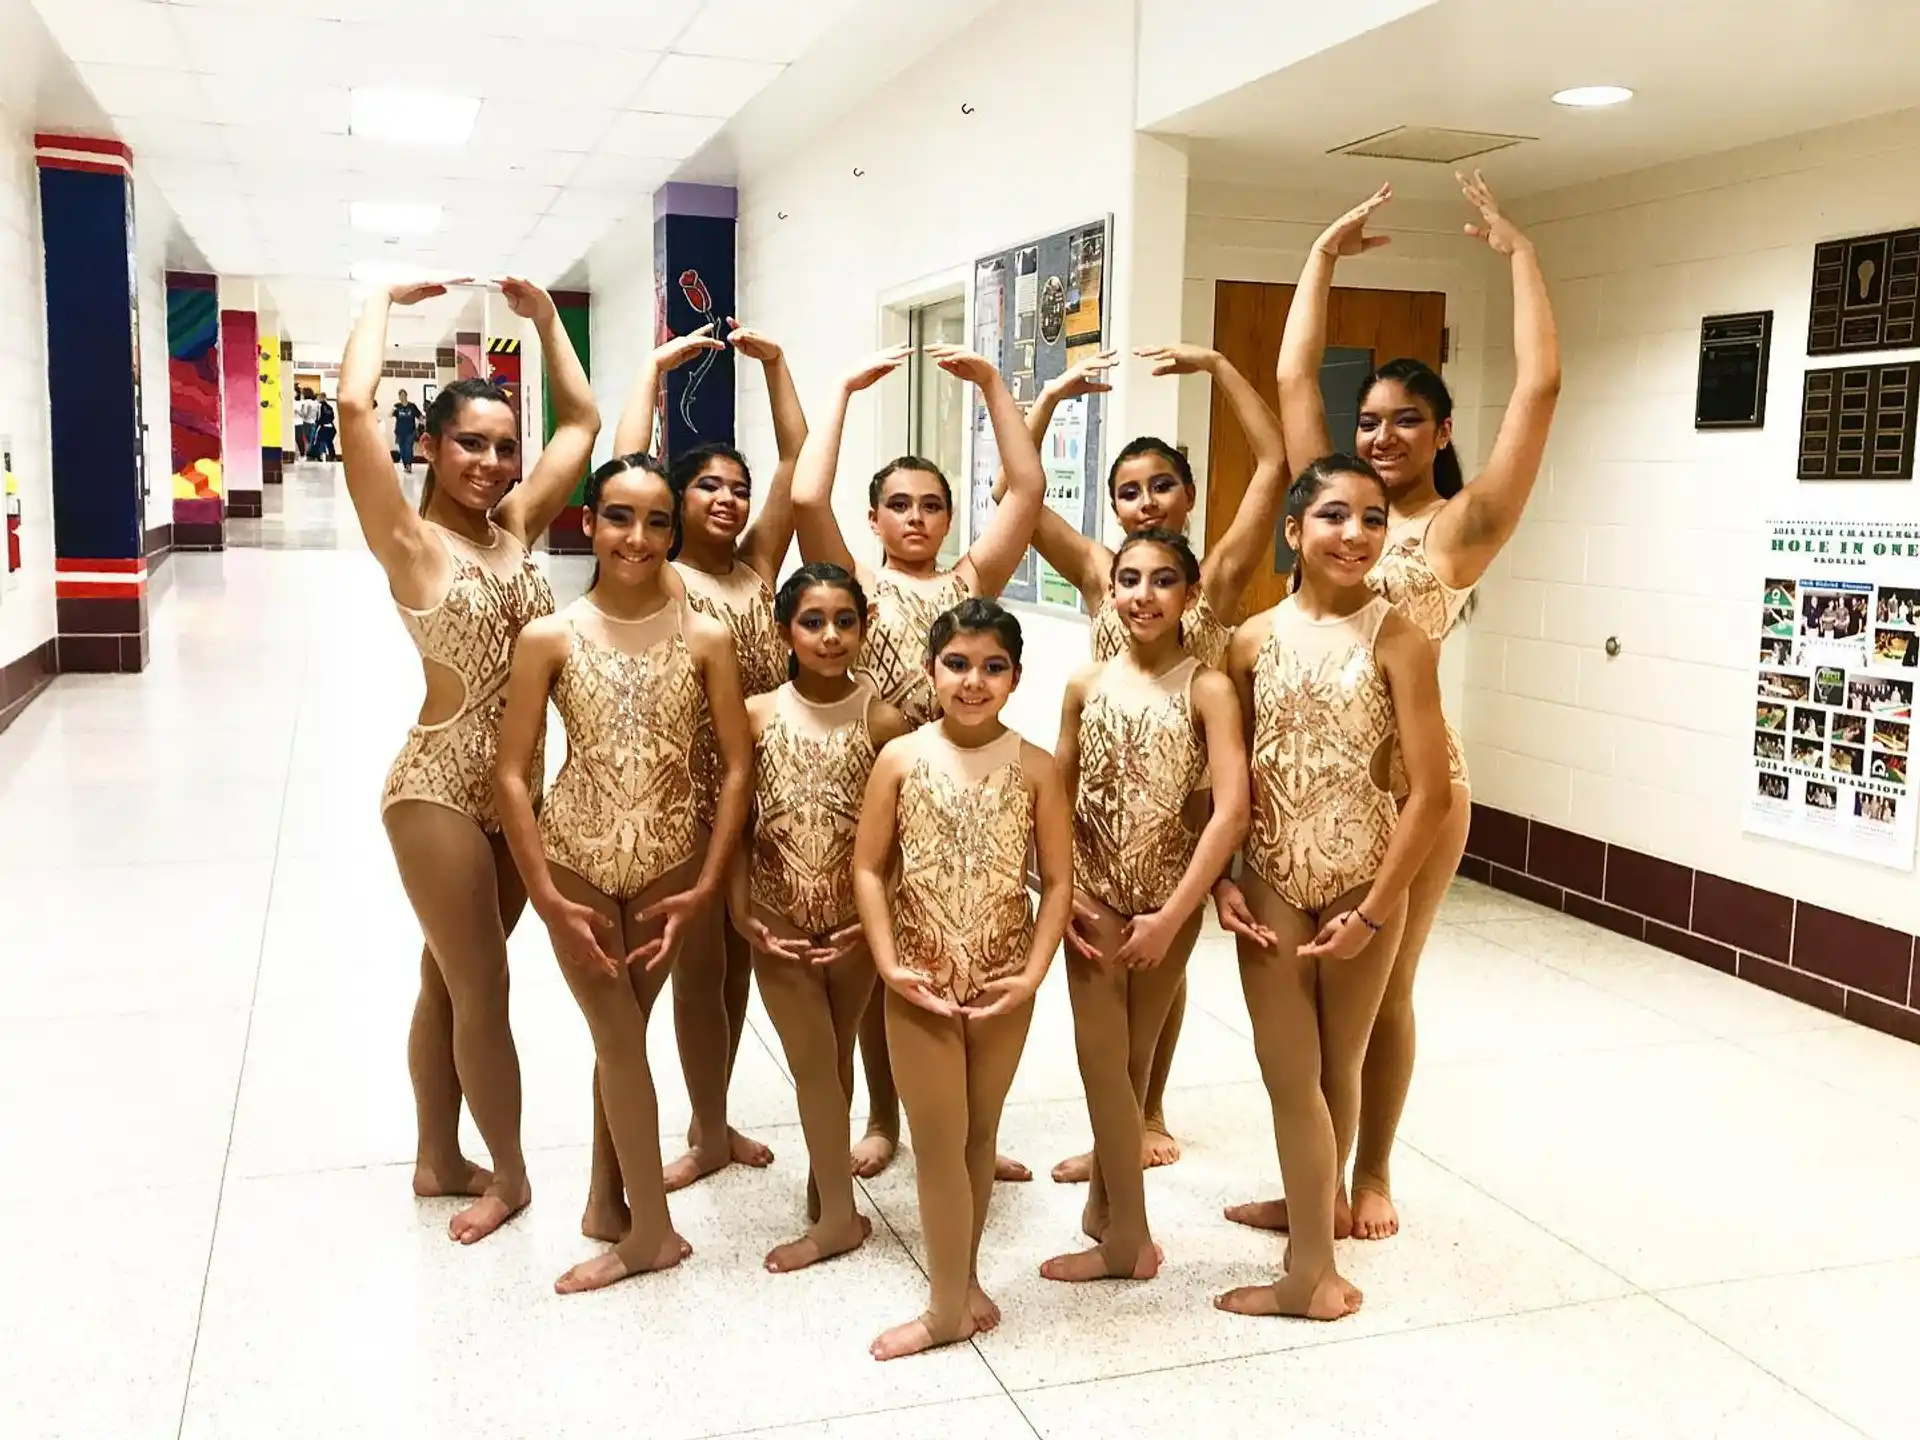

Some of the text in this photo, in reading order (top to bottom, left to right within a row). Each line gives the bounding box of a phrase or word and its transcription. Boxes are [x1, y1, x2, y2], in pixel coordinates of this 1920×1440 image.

[1771, 539, 1919, 557] HOLE IN ONE
[1782, 766, 1825, 780] SCHOOL
[1831, 775, 1907, 796] CHAMPIONS
